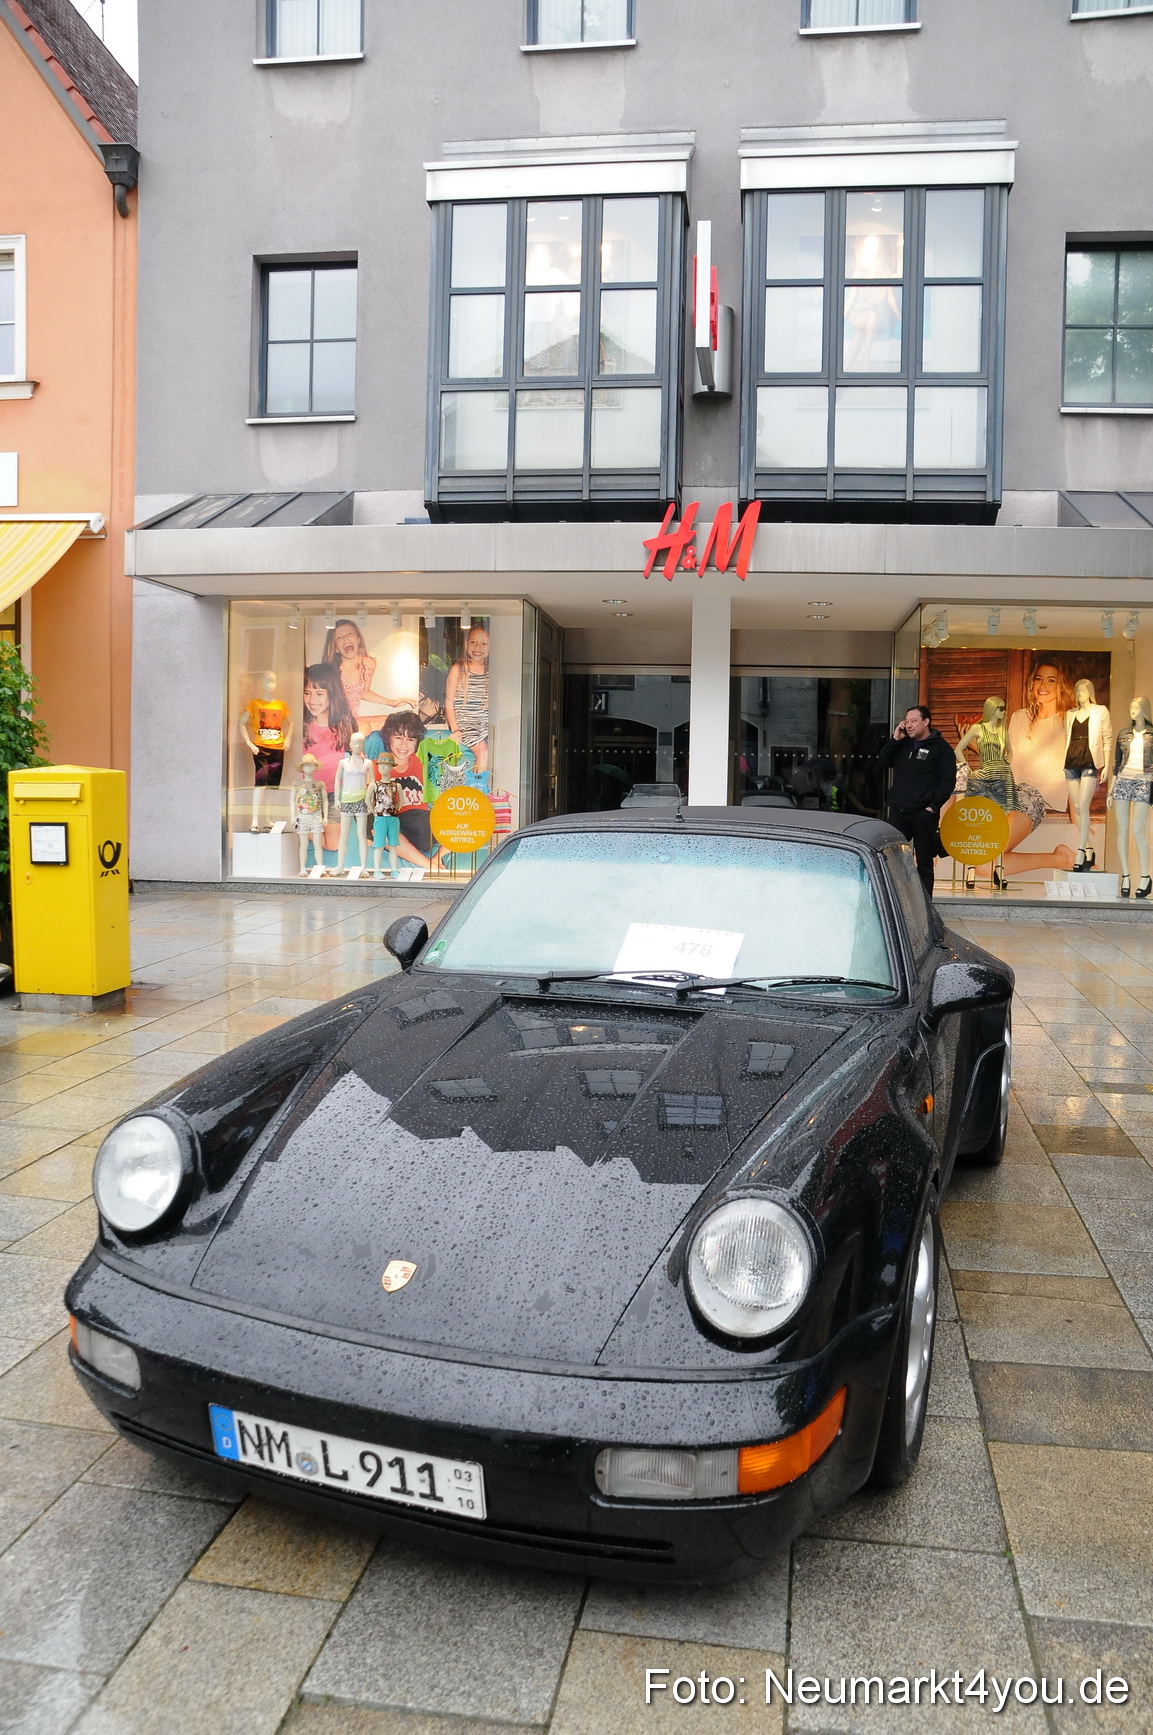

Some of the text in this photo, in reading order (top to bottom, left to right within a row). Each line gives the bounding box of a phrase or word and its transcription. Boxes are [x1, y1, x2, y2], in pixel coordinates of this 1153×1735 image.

[642, 500, 761, 581] H&M
[447, 797, 479, 811] 30%
[958, 808, 992, 822] 30%
[439, 829, 486, 837] AUSGEWÄHLTE
[949, 841, 999, 849] AUSGEWÄHLTE
[674, 941, 713, 957] 478
[222, 1436, 232, 1450] D
[237, 1418, 444, 1503] NM L 911
[453, 1468, 473, 1482] 03
[457, 1496, 475, 1510] 10
